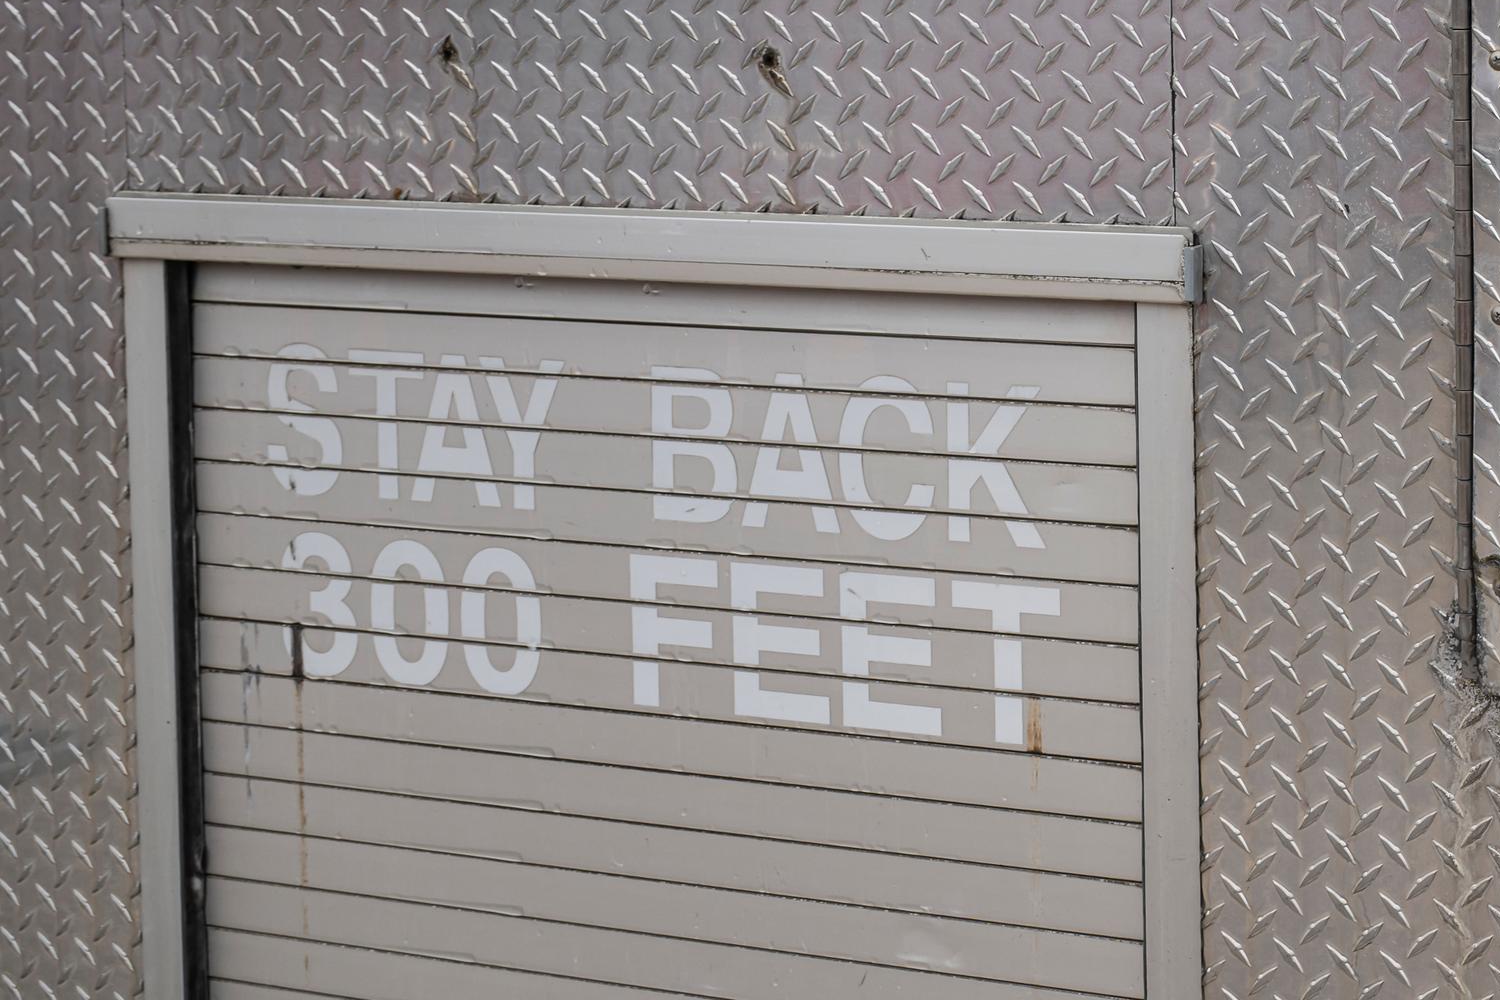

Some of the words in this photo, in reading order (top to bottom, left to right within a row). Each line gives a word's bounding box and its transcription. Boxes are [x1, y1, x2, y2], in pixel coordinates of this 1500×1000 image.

[266, 342, 565, 512] STAY
[650, 364, 1047, 550] BACK
[280, 531, 543, 696] 300
[629, 553, 1062, 746] FEET
